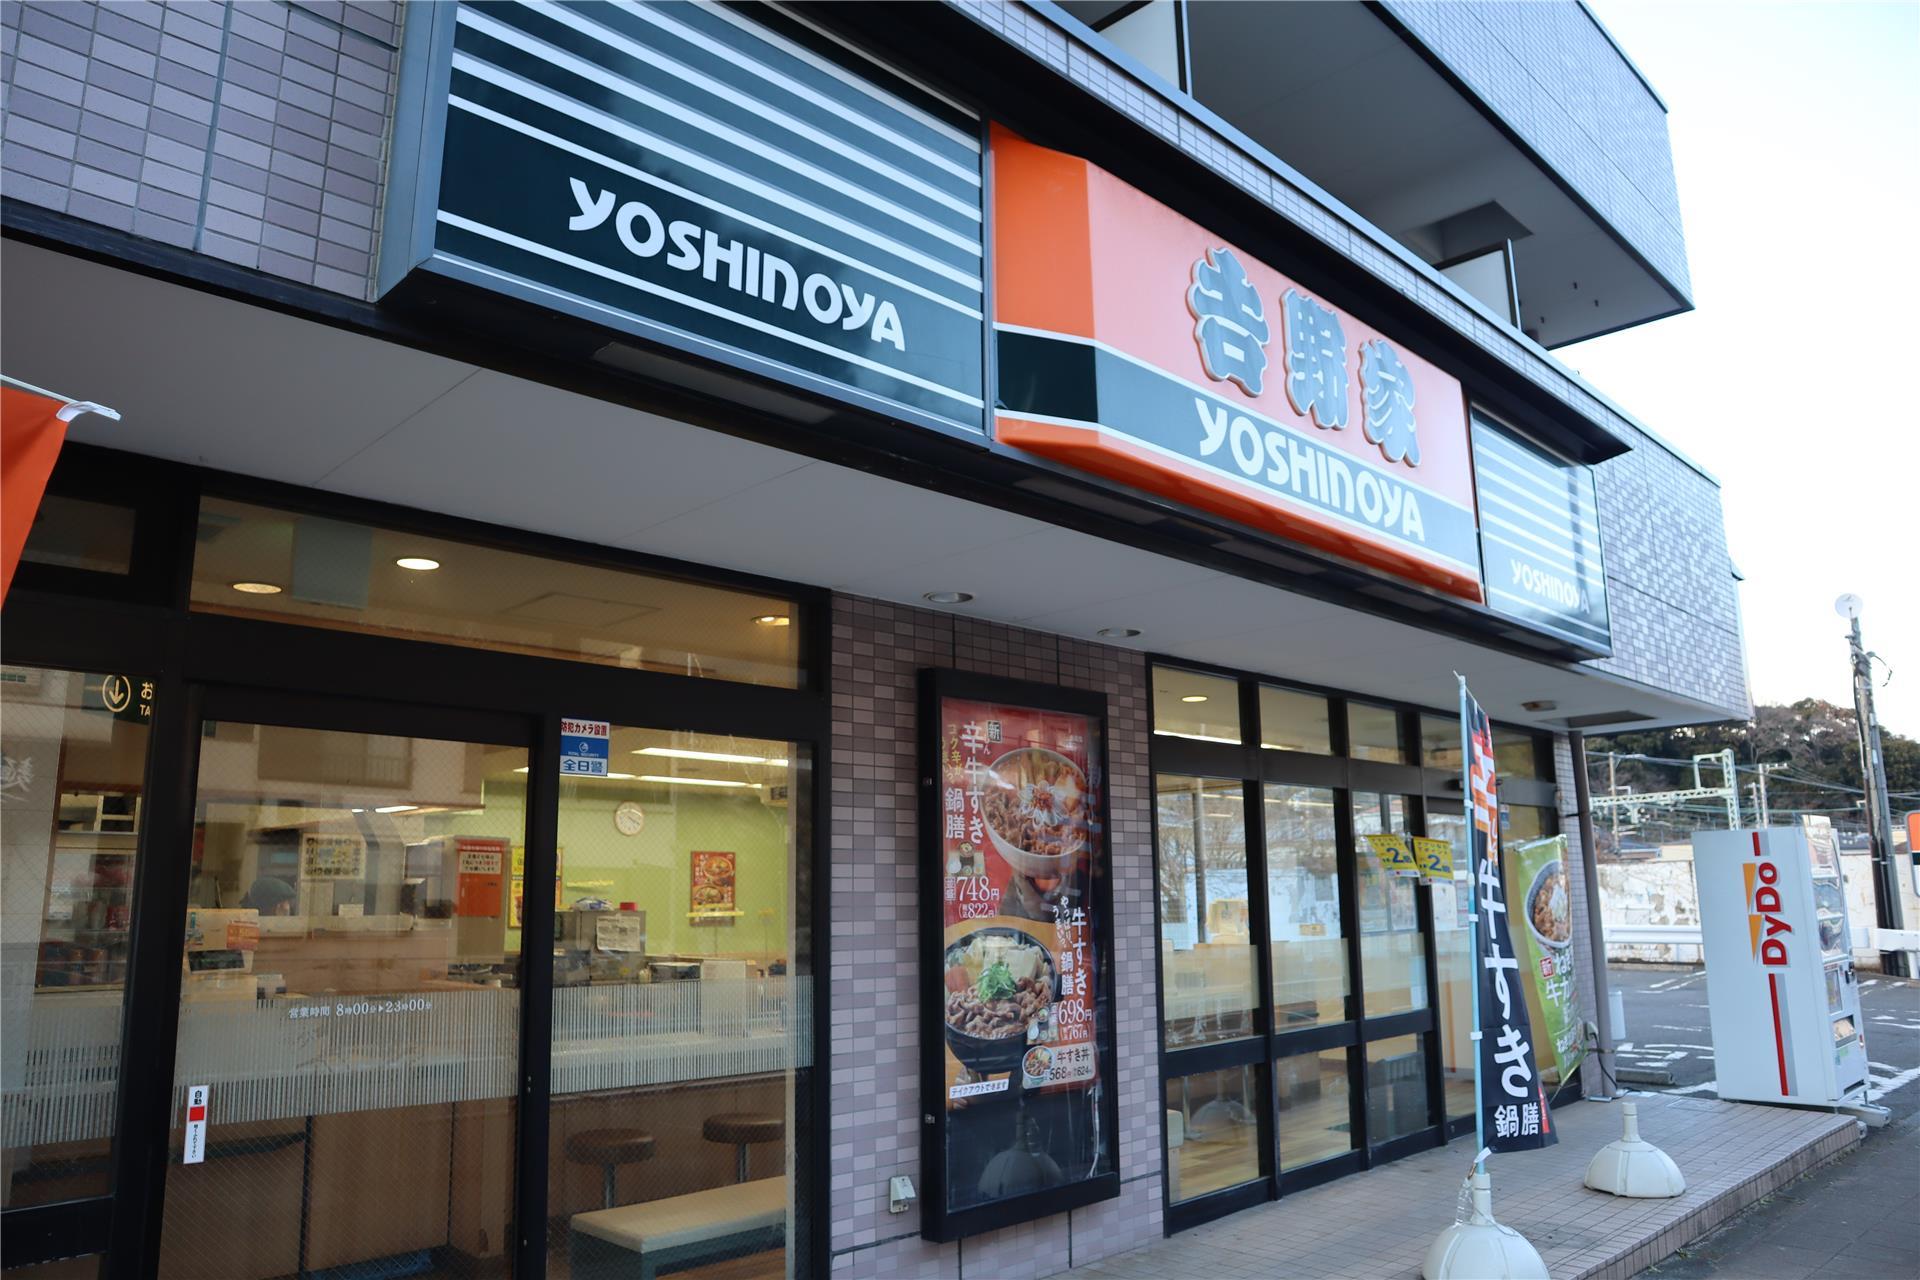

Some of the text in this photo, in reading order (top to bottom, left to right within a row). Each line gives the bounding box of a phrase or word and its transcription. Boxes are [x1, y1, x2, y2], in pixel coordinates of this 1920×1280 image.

[569, 177, 905, 351] YOSHINOYA
[1186, 247, 1421, 468] 吉野家
[1195, 397, 1425, 541] YOSHINOYA
[561, 721, 607, 736] 防犯カメラ設置
[987, 721, 1001, 742] 新
[563, 759, 603, 773] 全日警
[960, 720, 985, 844] 辛牛すき
[945, 787, 966, 840] 鍋膳
[1756, 862, 1792, 965] DyDo
[1061, 951, 1074, 995] 鍋膳
[1072, 907, 1087, 995] 牛すき
[289, 1005, 330, 1019] 営業時間
[1494, 1102, 1540, 1138] 鍋膳
